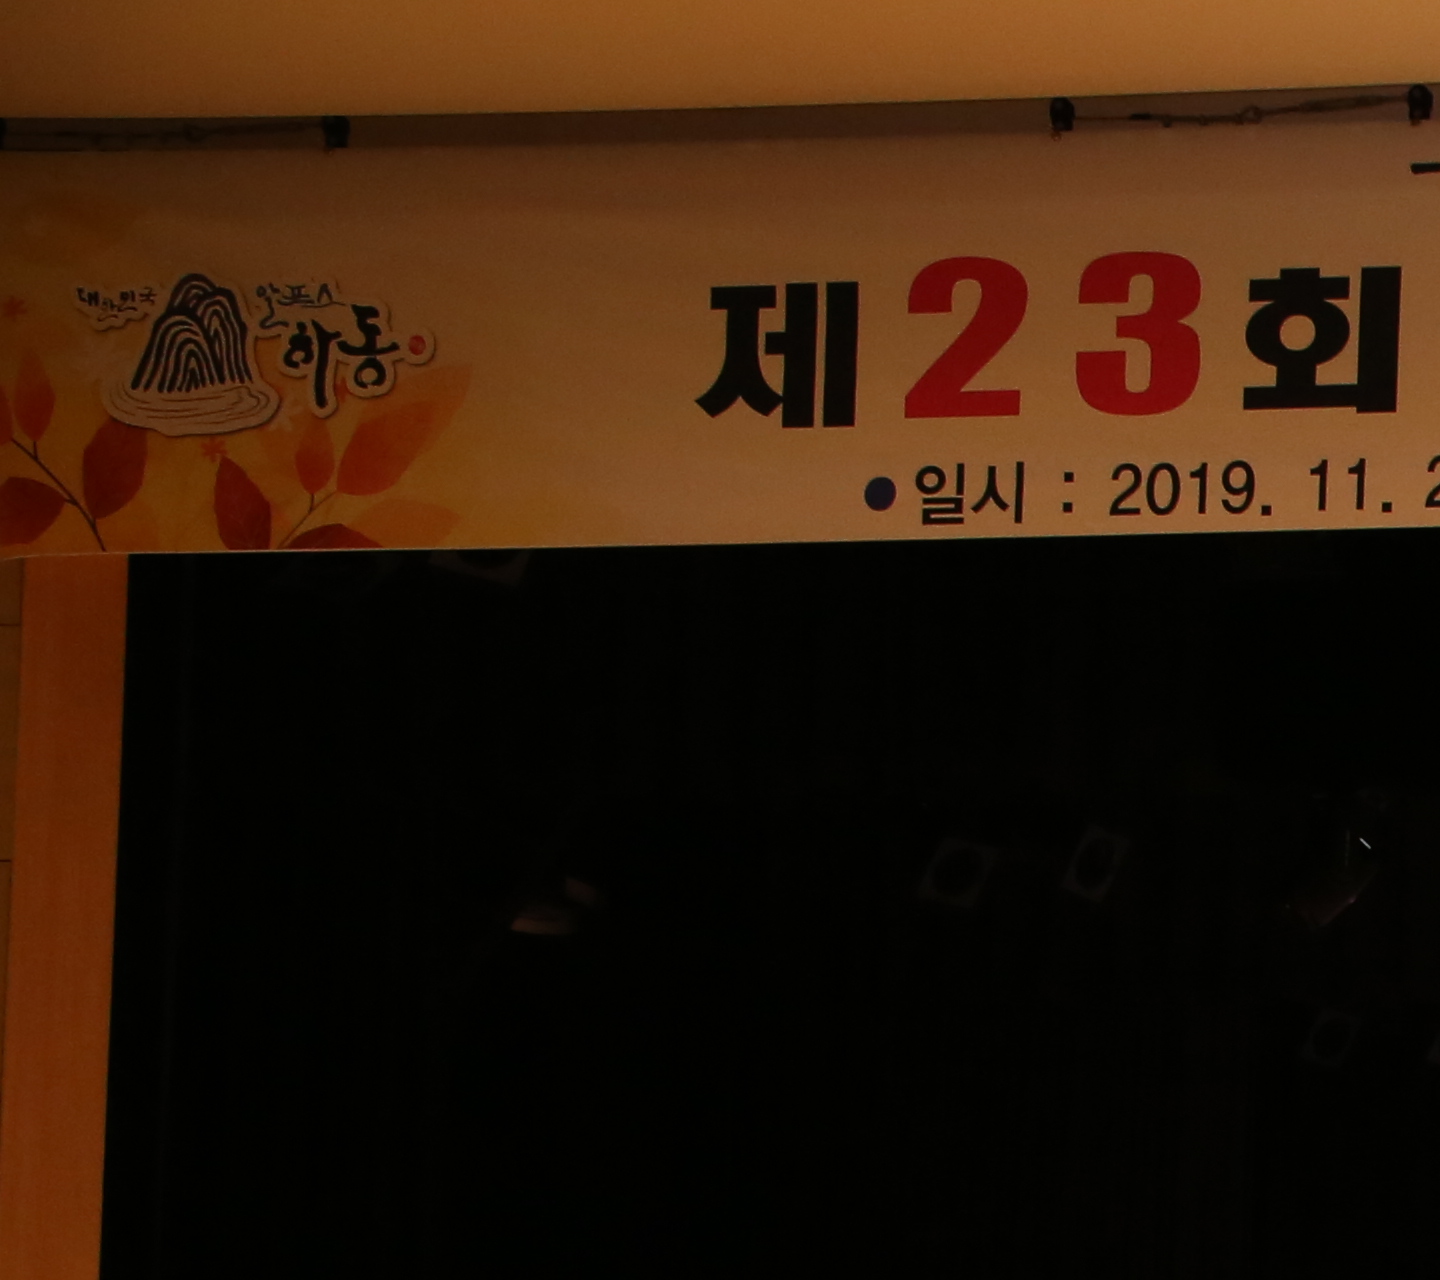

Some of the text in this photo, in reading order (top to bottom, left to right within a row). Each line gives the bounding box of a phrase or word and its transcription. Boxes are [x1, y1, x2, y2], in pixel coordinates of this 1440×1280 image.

[283, 304, 400, 408] 하동
[695, 251, 1401, 428] 제23회
[916, 462, 1024, 525] 일시
[1110, 461, 1271, 516] 2019.
[1310, 458, 1392, 513] 11.
